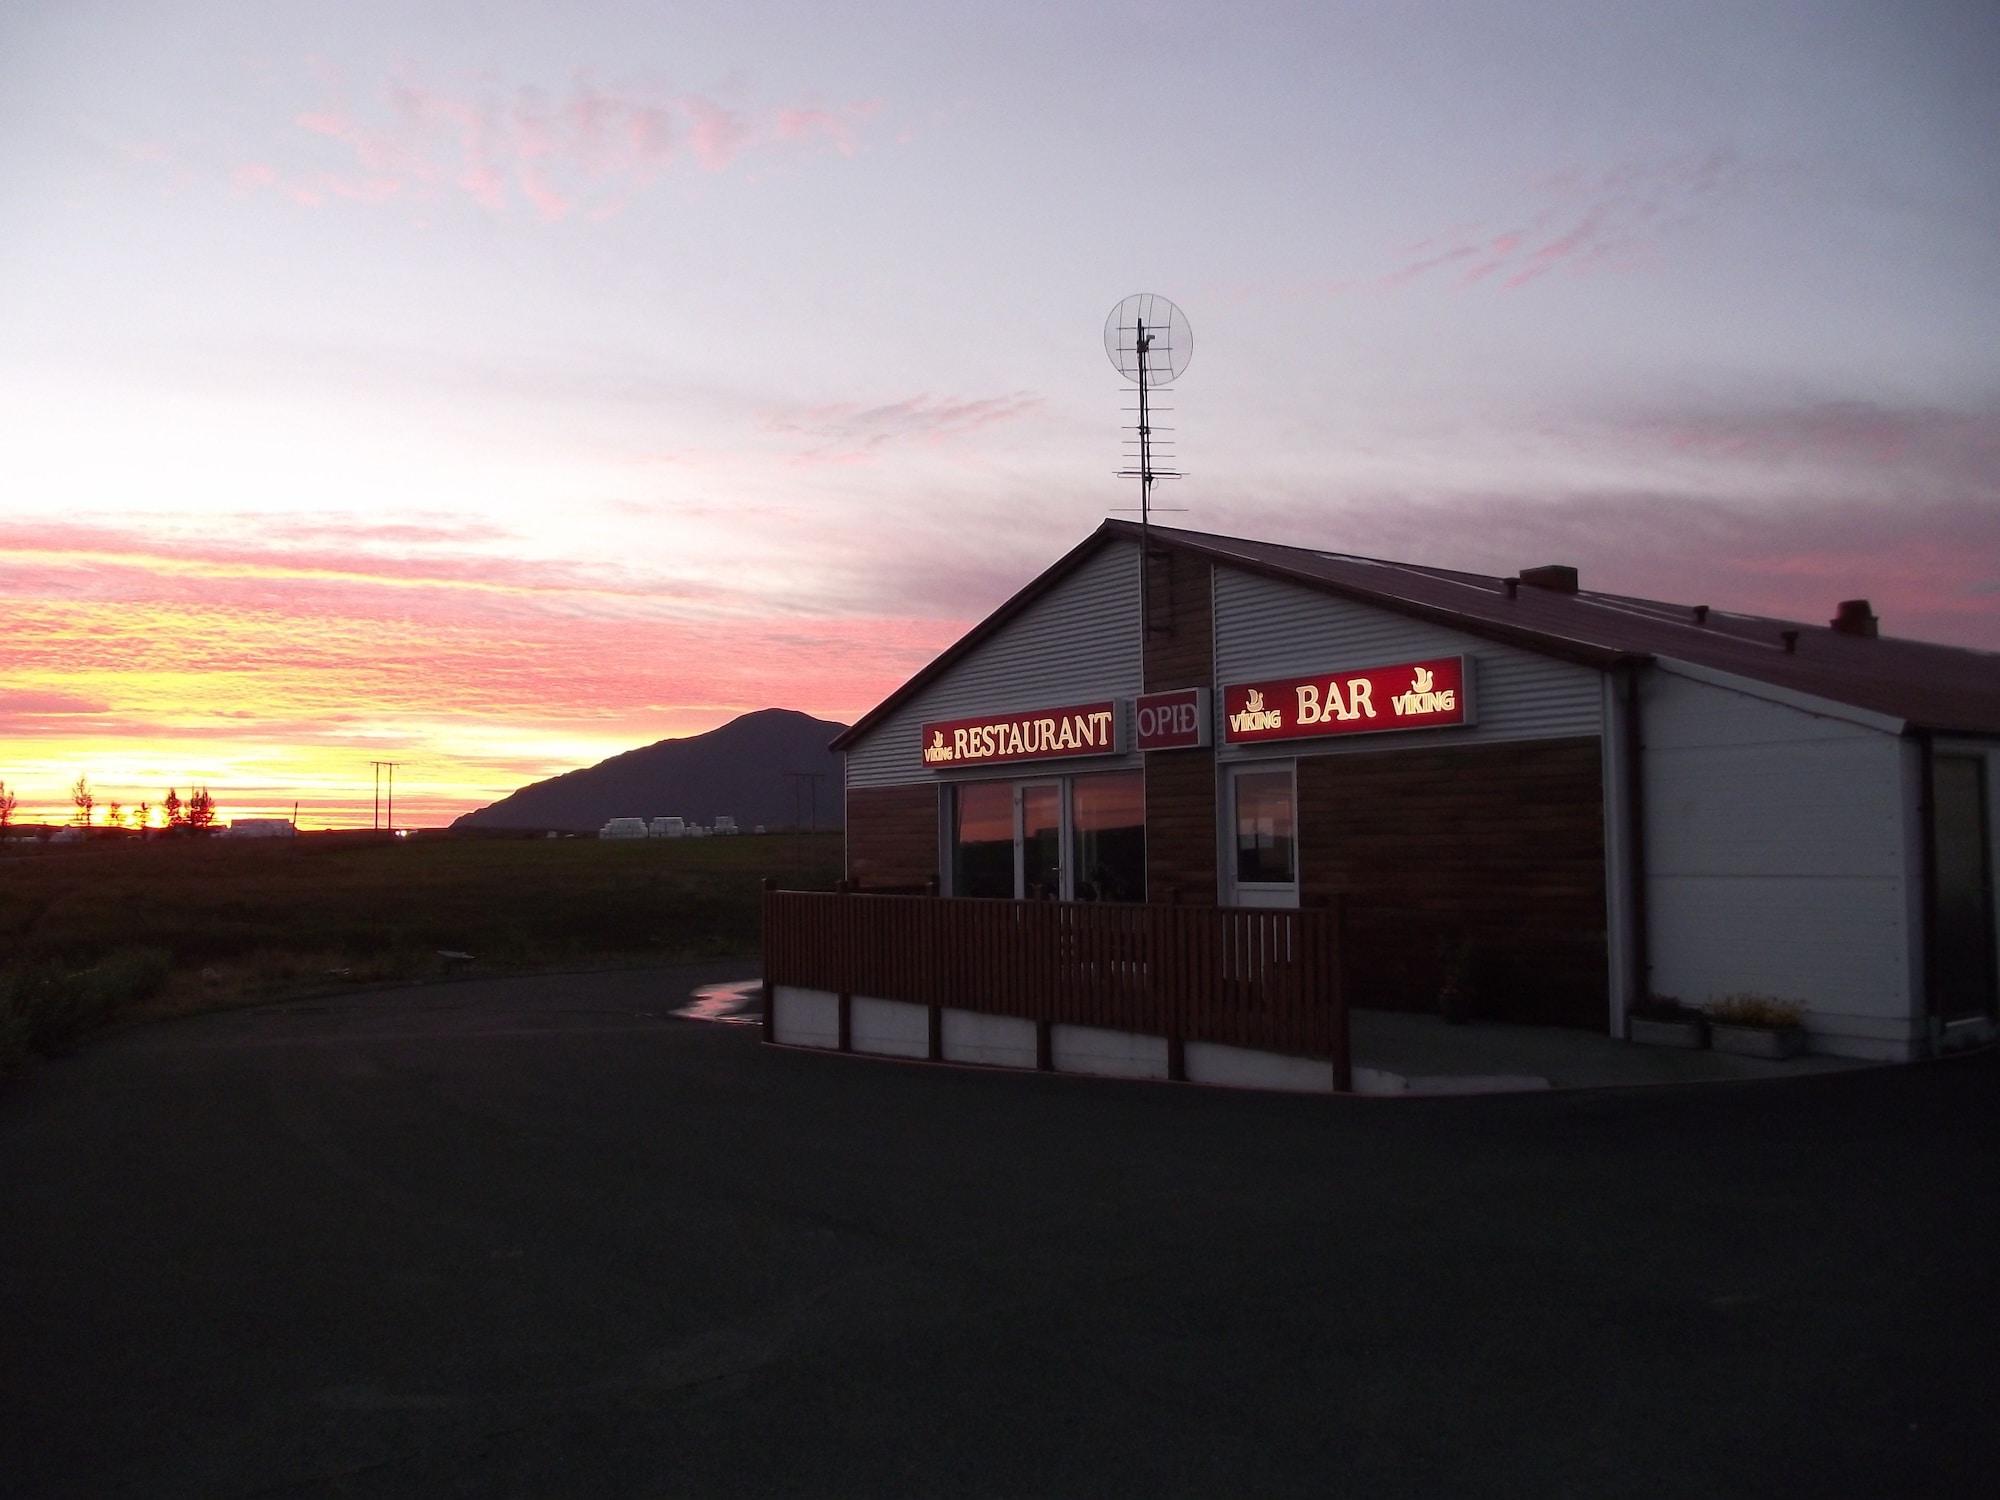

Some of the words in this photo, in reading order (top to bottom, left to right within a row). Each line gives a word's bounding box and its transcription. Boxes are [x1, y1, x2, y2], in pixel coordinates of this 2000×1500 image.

[1137, 703, 1197, 737] OPIÐ
[1296, 678, 1377, 725] BAR
[953, 711, 1112, 760] RESTAURANT
